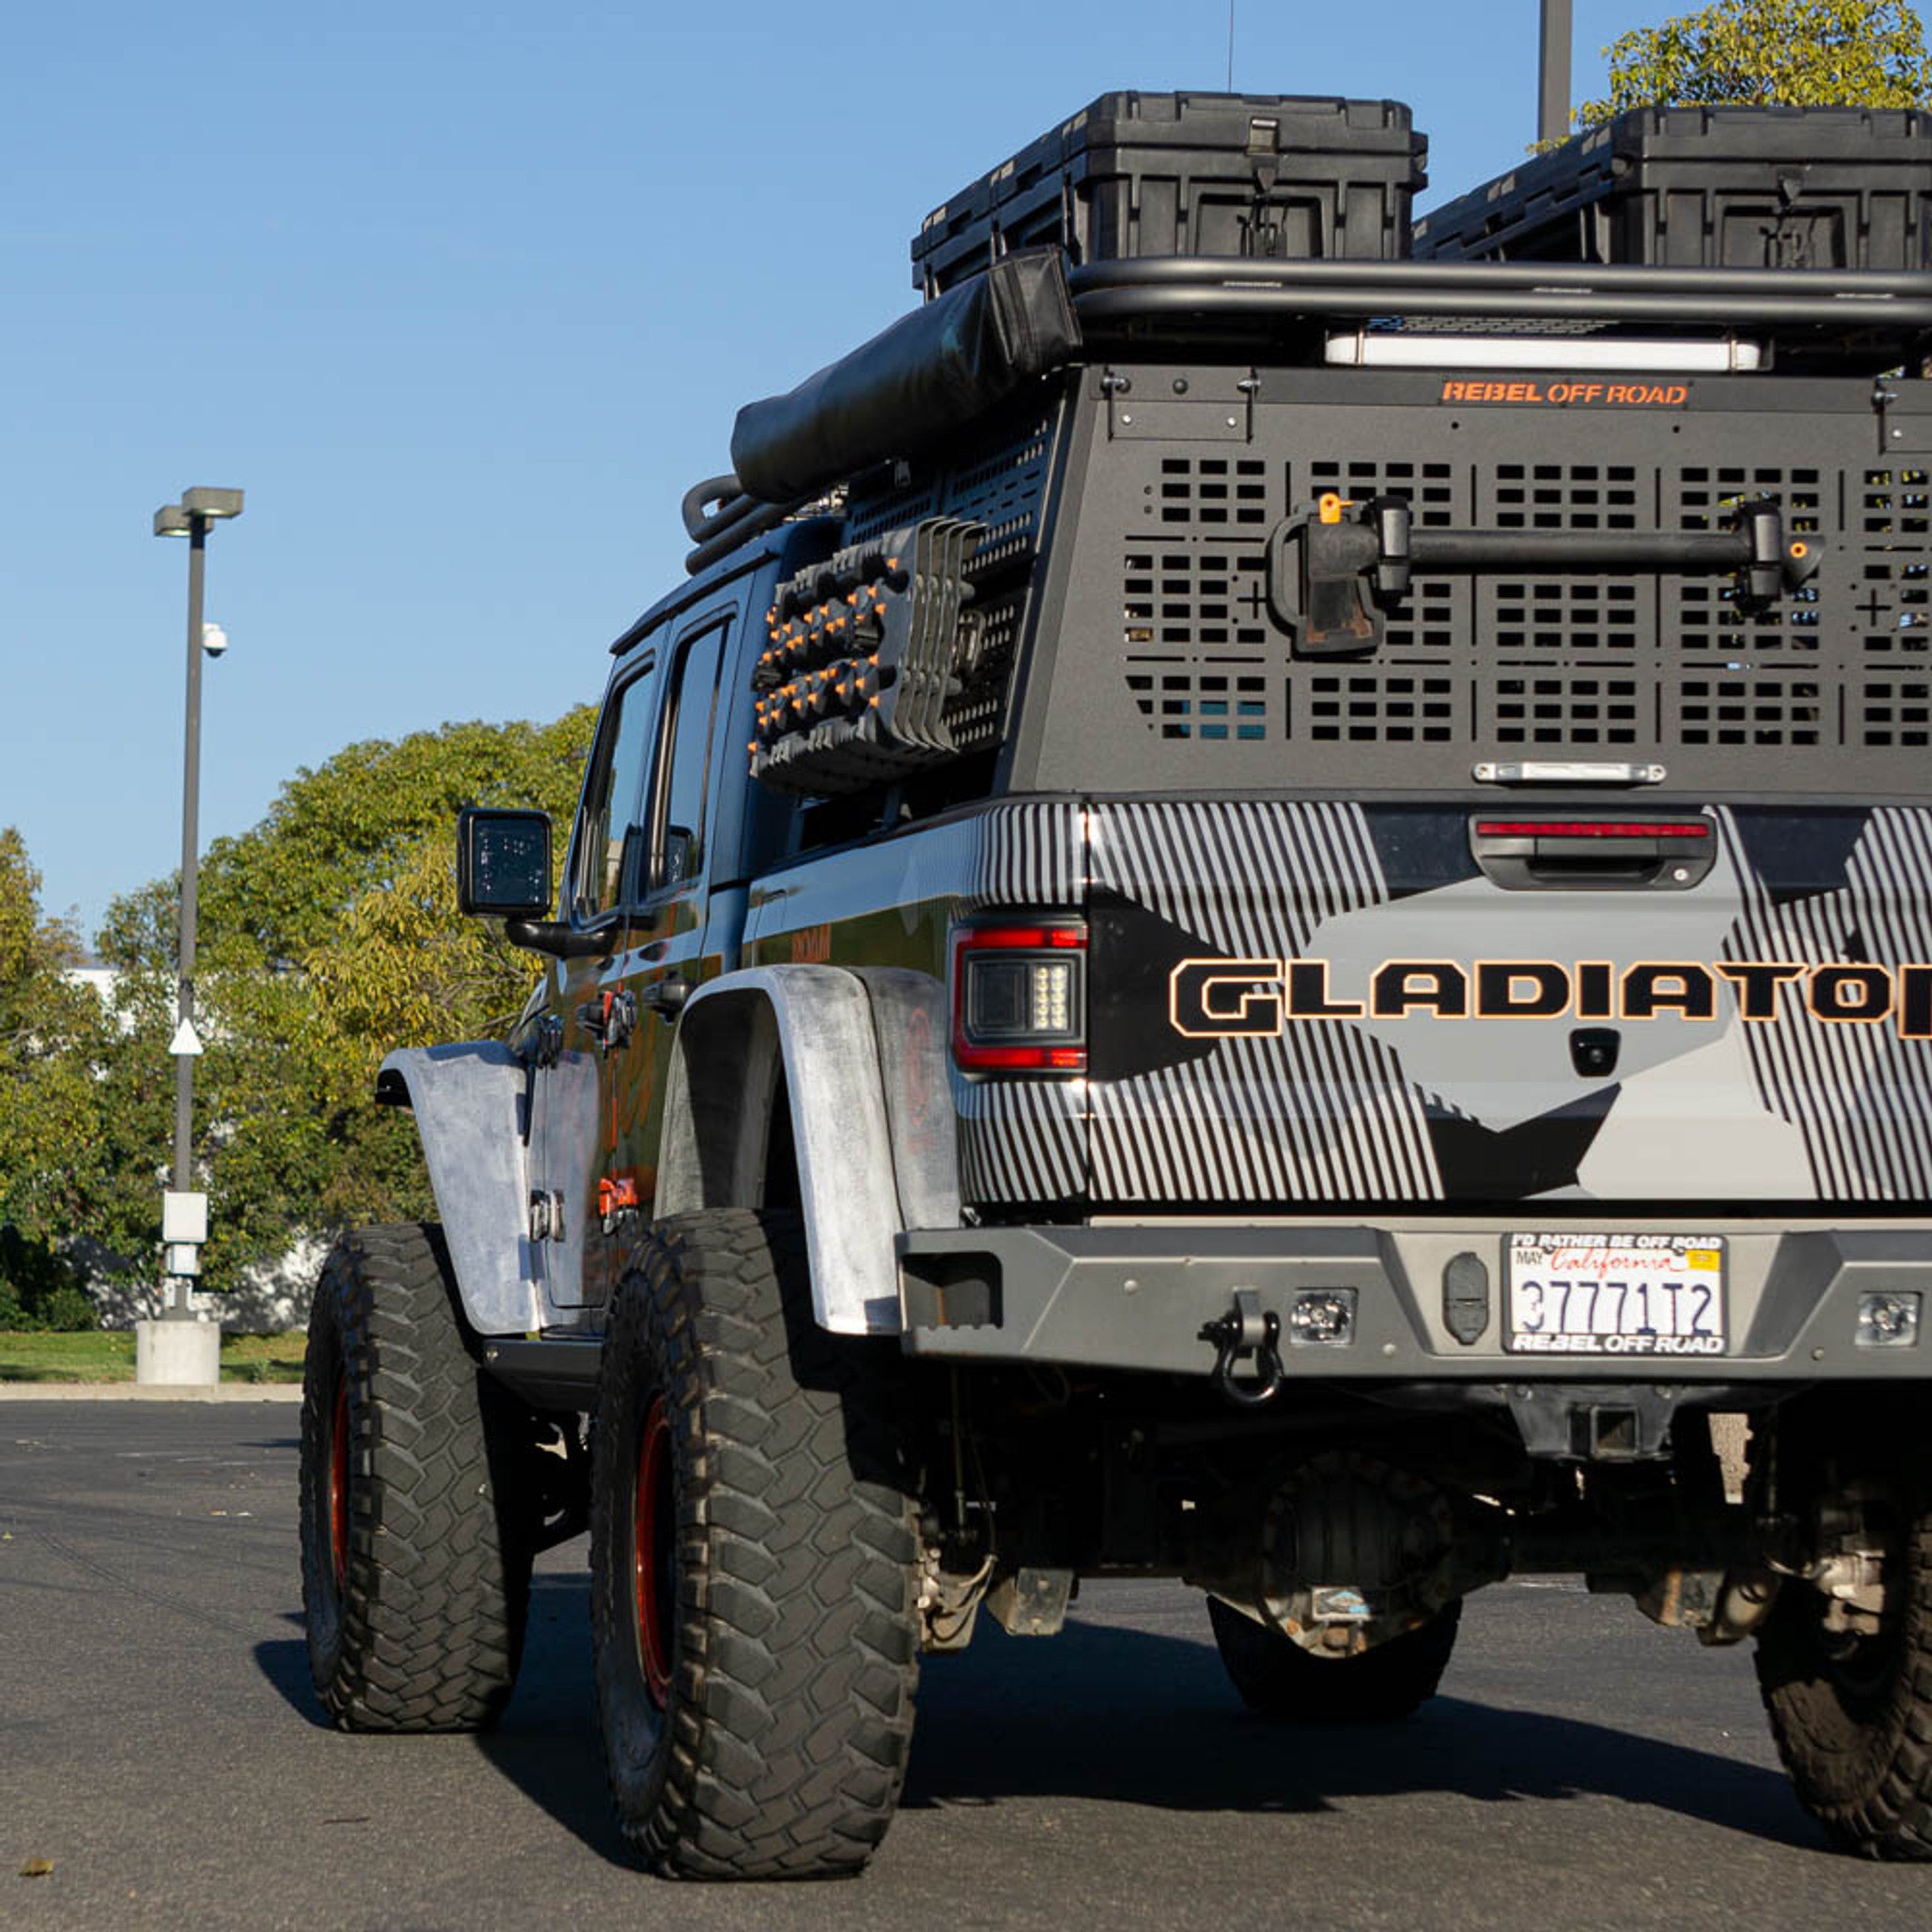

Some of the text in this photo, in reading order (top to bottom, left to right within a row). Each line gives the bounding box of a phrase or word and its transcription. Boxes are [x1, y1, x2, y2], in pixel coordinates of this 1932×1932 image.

[1443, 380, 1687, 404] REBEL OFF ROAD
[1540, 1234, 1606, 1248] RATHER
[1610, 1235, 1636, 1248] BE
[1637, 1235, 1672, 1247] OFF
[1672, 1236, 1721, 1250] ROAD
[1517, 1251, 1543, 1264] MAY
[1551, 1247, 1685, 1278] California
[1512, 1334, 1724, 1353] REBEL OFF ROAD
